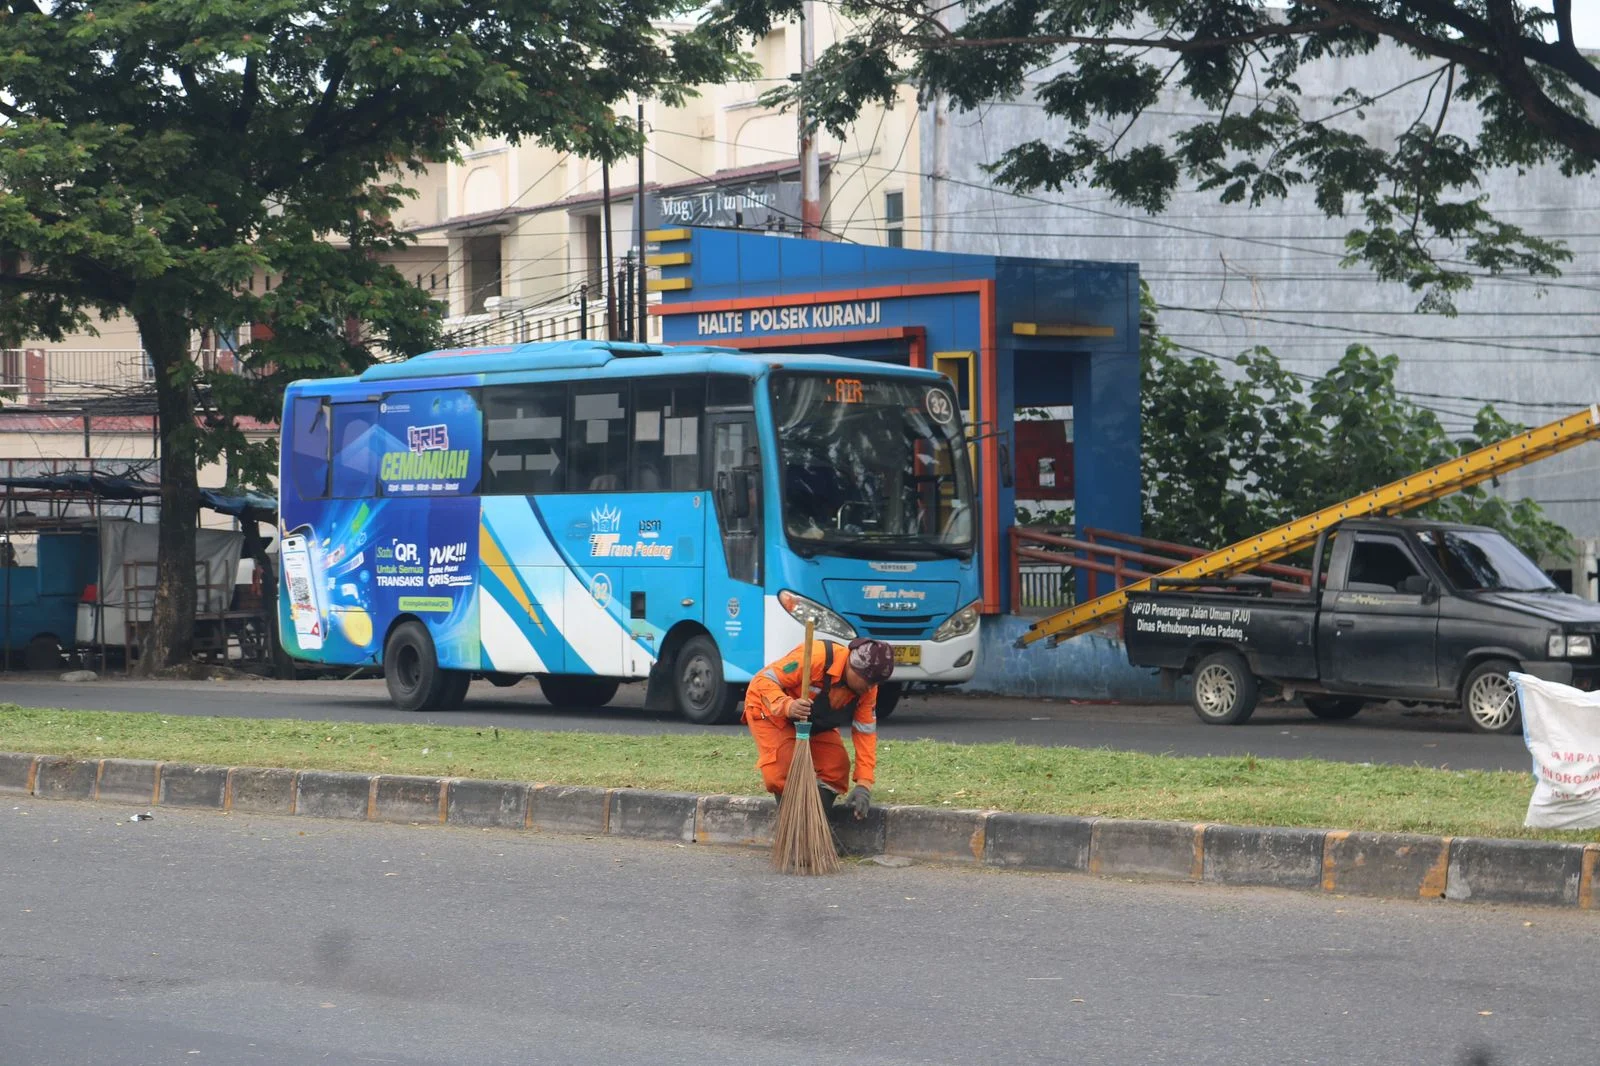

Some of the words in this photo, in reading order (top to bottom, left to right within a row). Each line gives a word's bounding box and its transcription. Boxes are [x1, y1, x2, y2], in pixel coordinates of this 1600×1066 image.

[717, 188, 776, 211] Furniture
[698, 312, 743, 335] HALTE
[750, 306, 809, 331] POLSEK
[812, 301, 881, 328] KURANJI
[930, 398, 949, 415] 32
[409, 425, 447, 455] QRIS
[381, 450, 469, 481] CEMUMUAH
[395, 543, 417, 562] QR
[429, 542, 467, 566] YUK!!!
[588, 533, 633, 557] Trans
[634, 541, 673, 560] Padang
[376, 565, 397, 574] Untuk
[399, 565, 424, 574] Semua
[427, 574, 449, 587] QRIS
[376, 576, 424, 587] TRANSAKSI
[595, 582, 608, 600] 32
[1132, 602, 1151, 615] UPTD
[1151, 604, 1190, 620] Penerangan
[1190, 606, 1208, 619] Jalan
[1209, 607, 1231, 620] Umum
[1231, 609, 1251, 625] (PJU)
[1137, 619, 1156, 632] Dinas
[1156, 620, 1200, 637] Perhubungan
[1201, 623, 1217, 637] Kota
[1217, 625, 1243, 642] Padang
